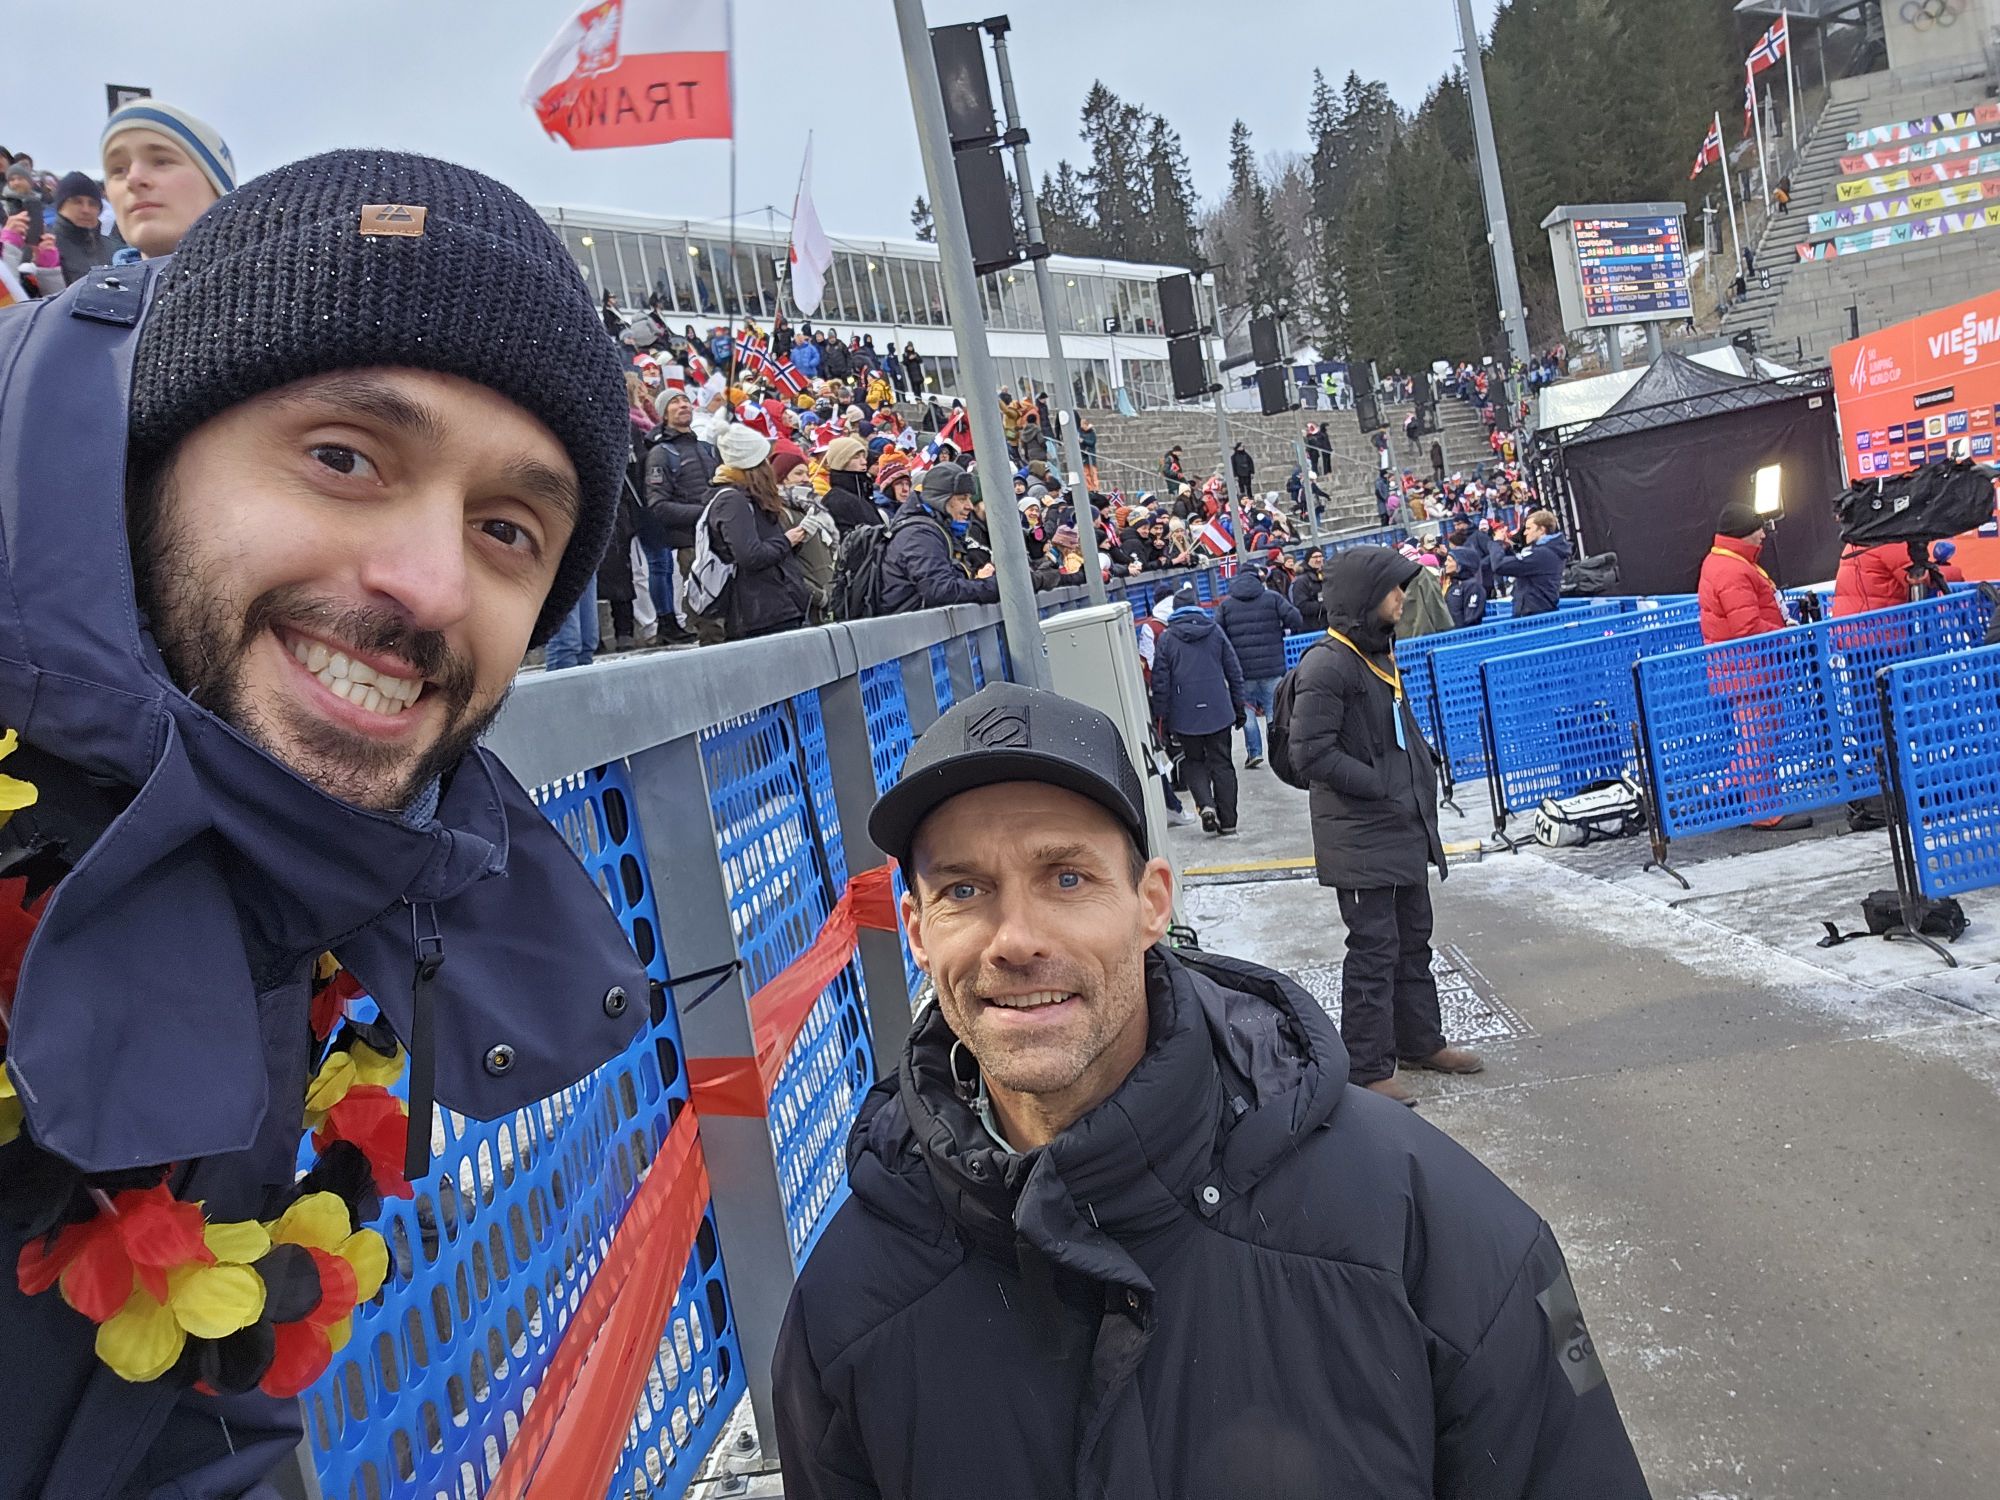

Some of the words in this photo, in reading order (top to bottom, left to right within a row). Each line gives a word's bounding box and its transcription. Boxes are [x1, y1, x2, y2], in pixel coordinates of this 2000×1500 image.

[1762, 270, 1768, 279] H
[1106, 319, 1115, 331] F
[1948, 413, 1966, 427] HYLO
[1972, 436, 1991, 450] HYLO
[1534, 811, 1553, 843] HH
